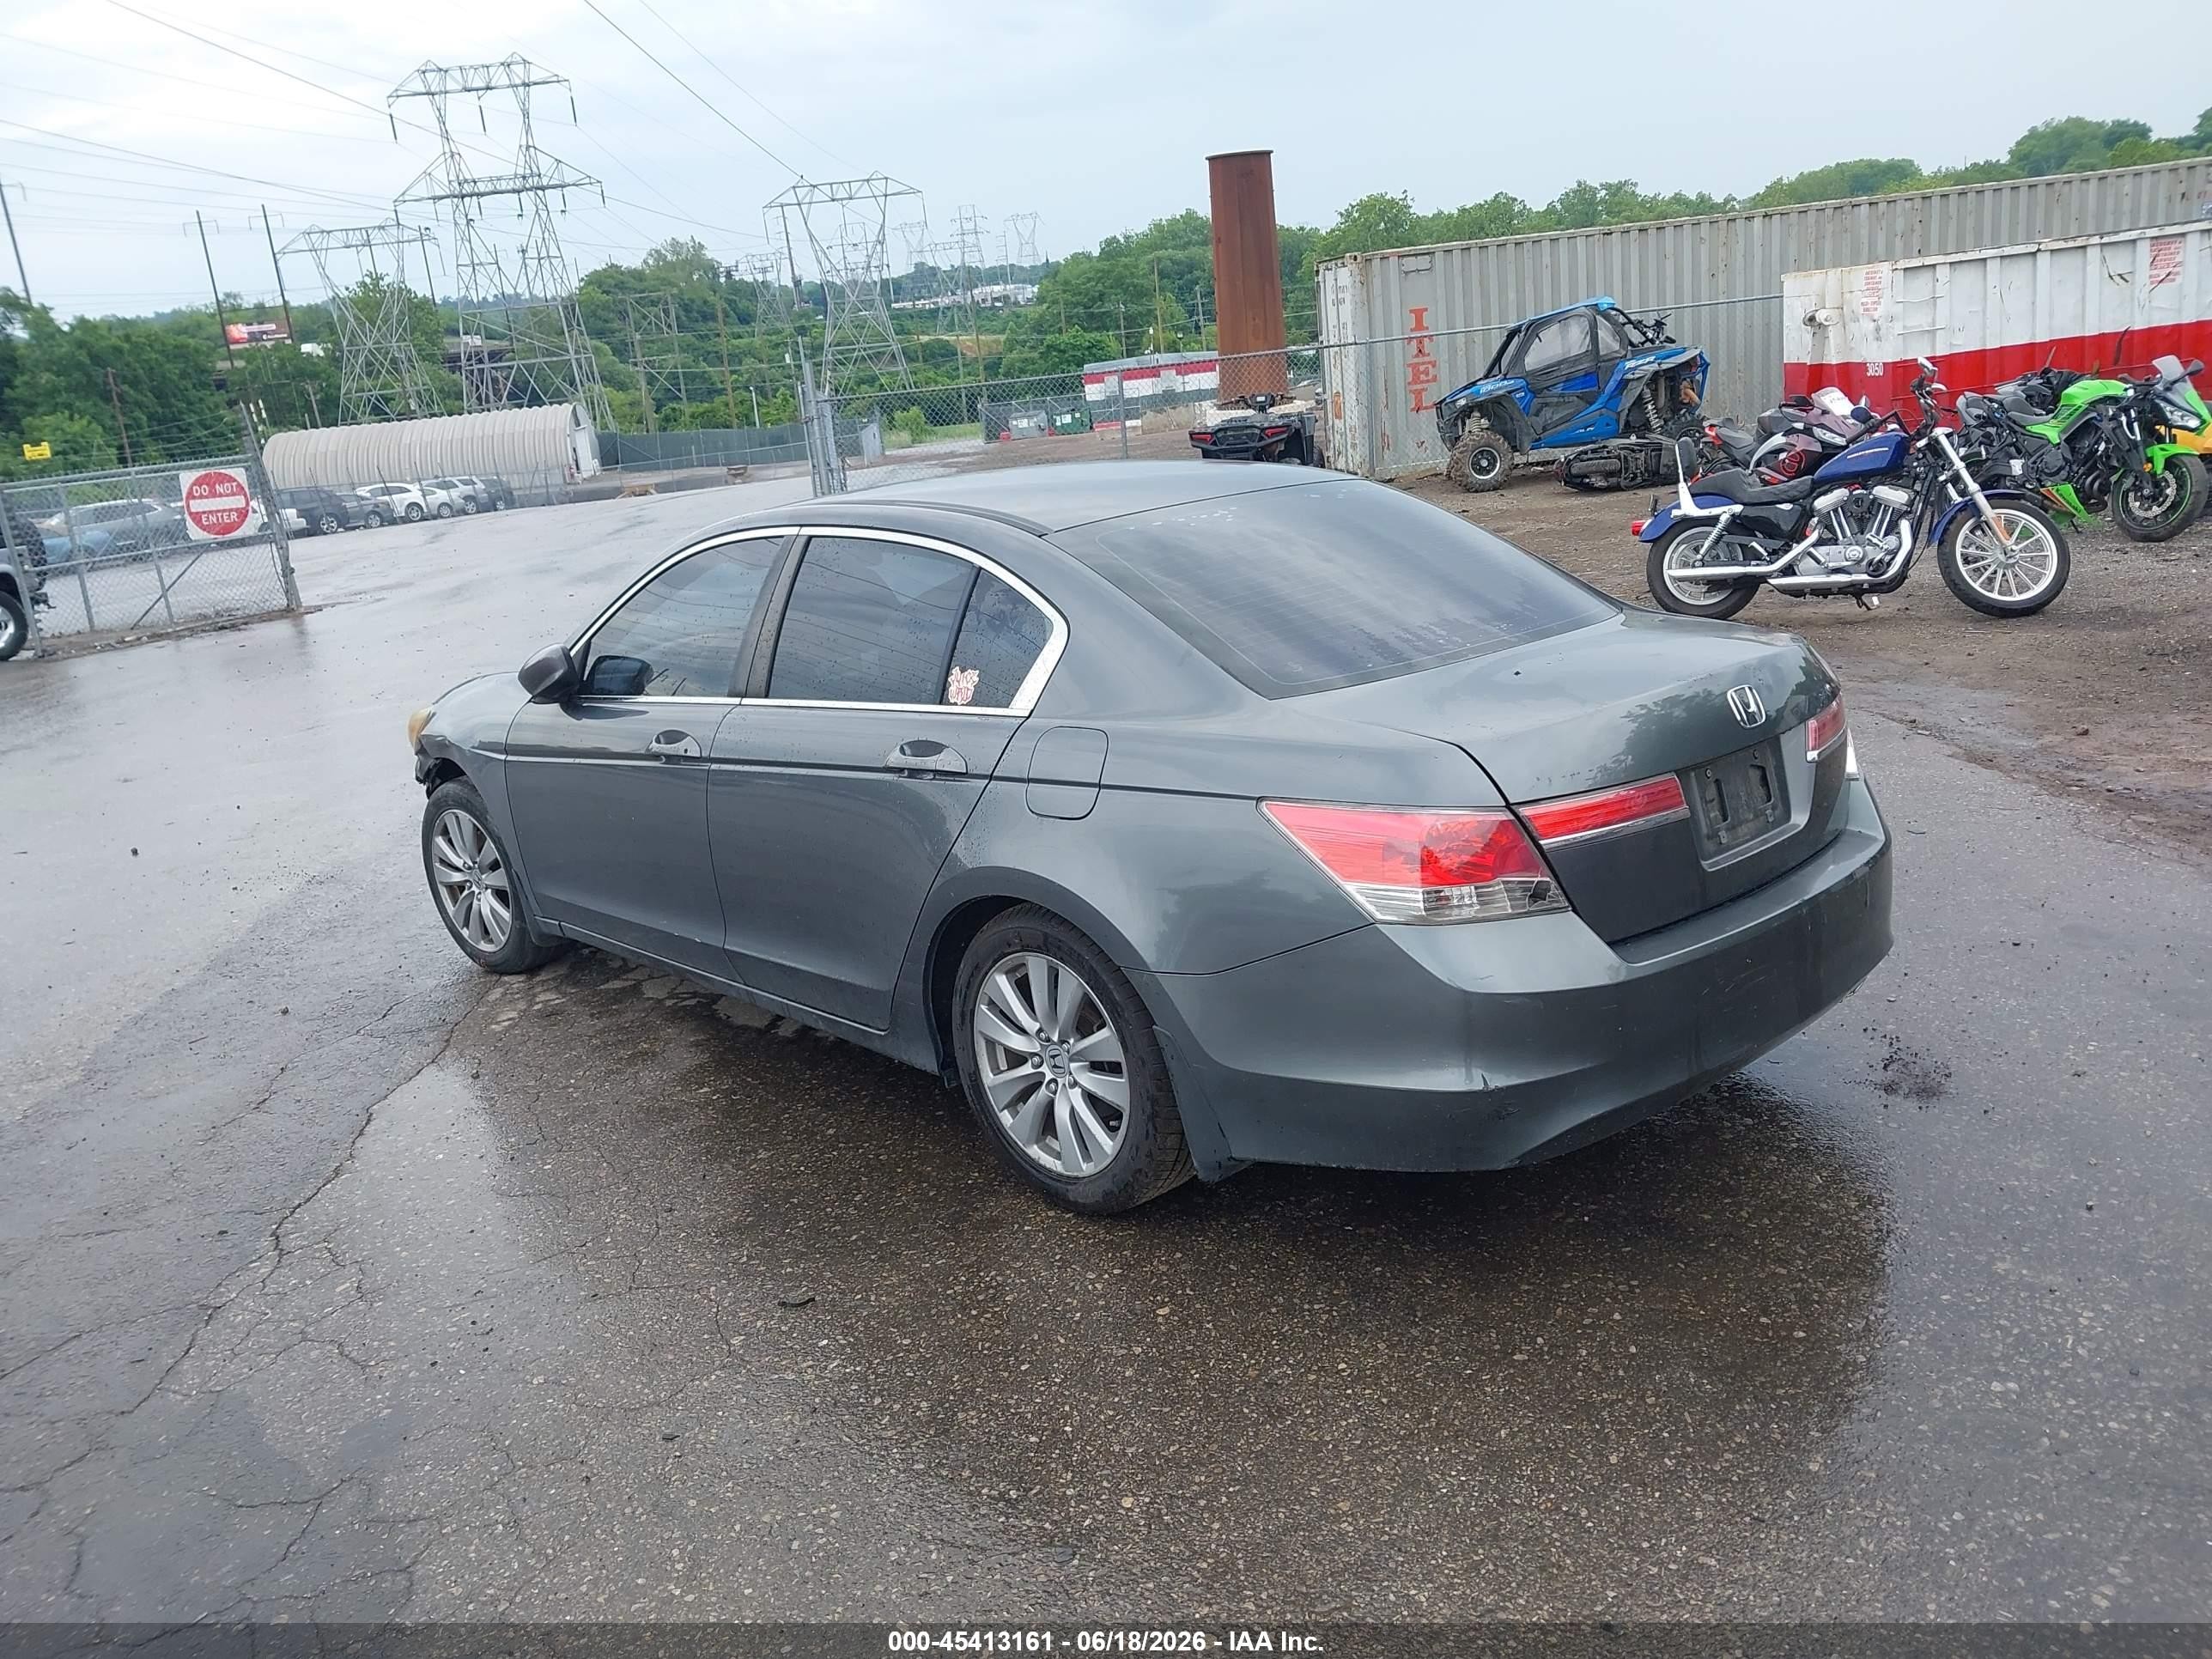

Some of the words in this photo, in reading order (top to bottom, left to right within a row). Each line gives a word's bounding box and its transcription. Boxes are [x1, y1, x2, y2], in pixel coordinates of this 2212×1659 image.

[1407, 307, 1437, 412] ITEL
[1866, 362, 1884, 377] 3050
[192, 485, 209, 496] DO
[216, 482, 238, 495] NOT
[202, 512, 238, 525] ENTER
